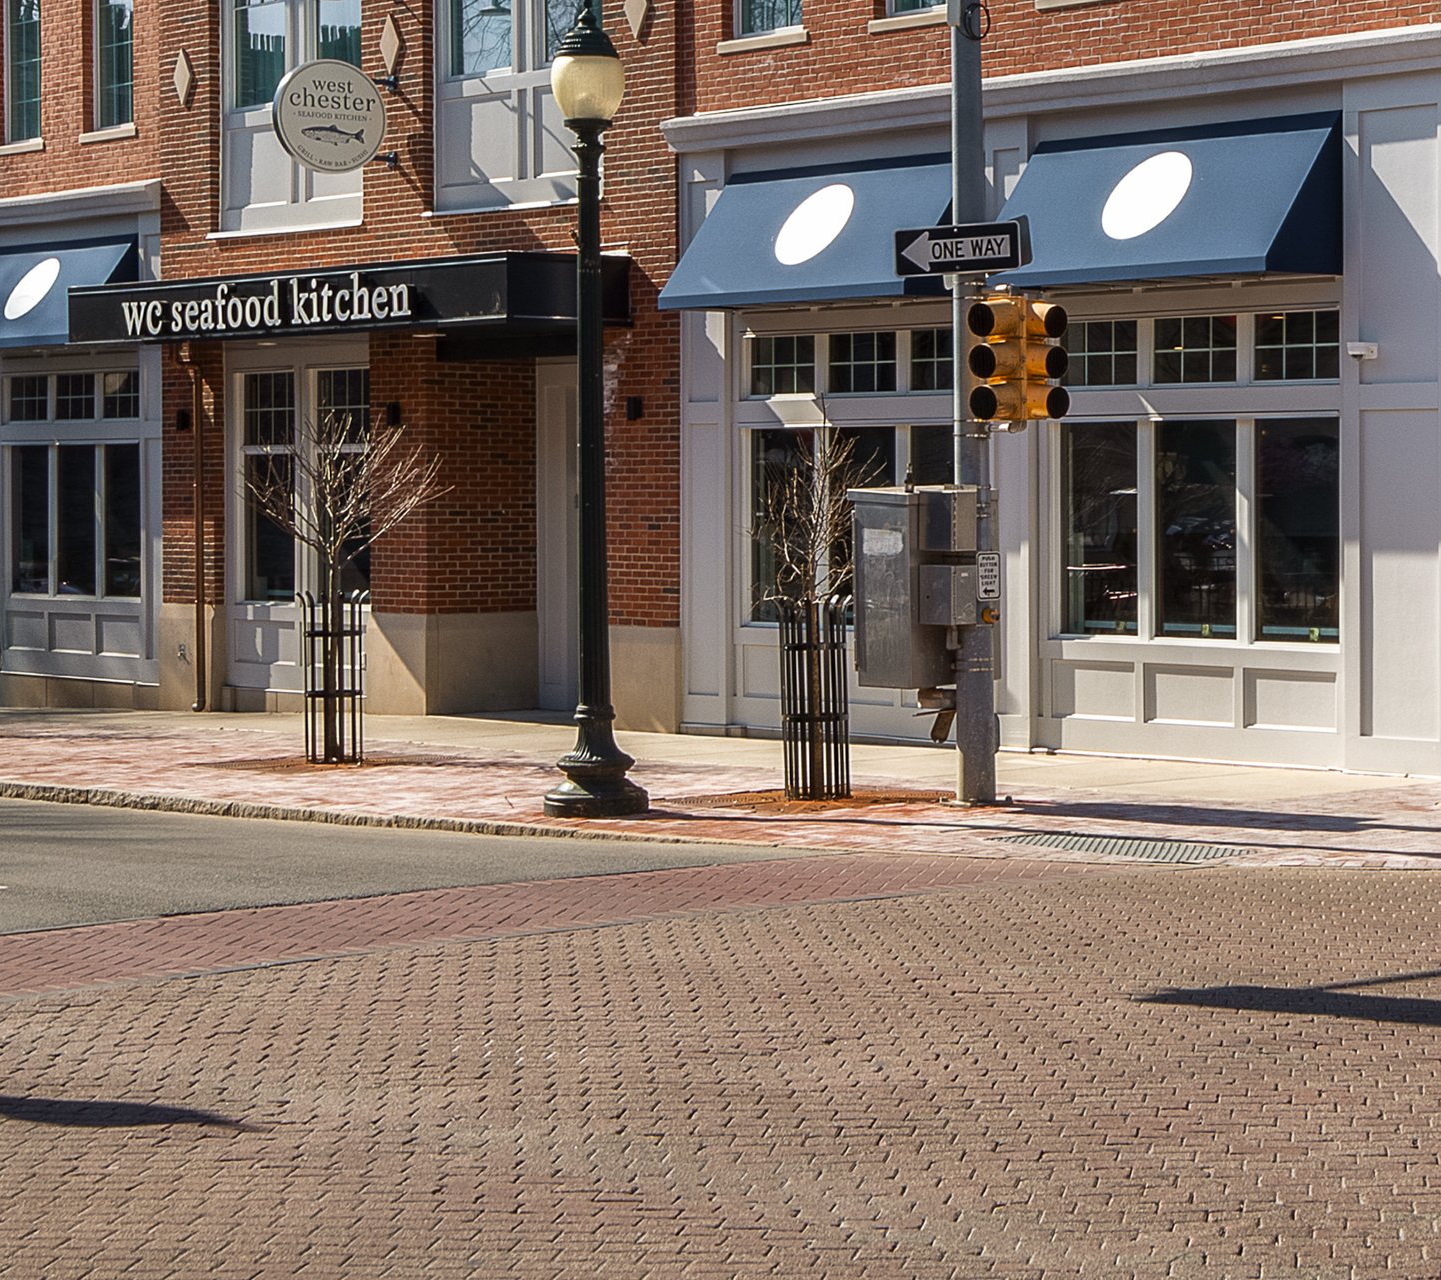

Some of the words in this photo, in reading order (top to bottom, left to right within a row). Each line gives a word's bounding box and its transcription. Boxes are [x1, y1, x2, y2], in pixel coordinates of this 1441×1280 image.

[312, 79, 354, 95] west
[289, 87, 376, 113] chester
[298, 110, 333, 120] SEAFOOD
[334, 113, 368, 122] KITCHEN
[931, 240, 965, 260] ONE
[970, 237, 1005, 257] WAY
[121, 299, 163, 336] wc
[170, 279, 282, 332] seafood
[289, 271, 412, 325] kitchen
